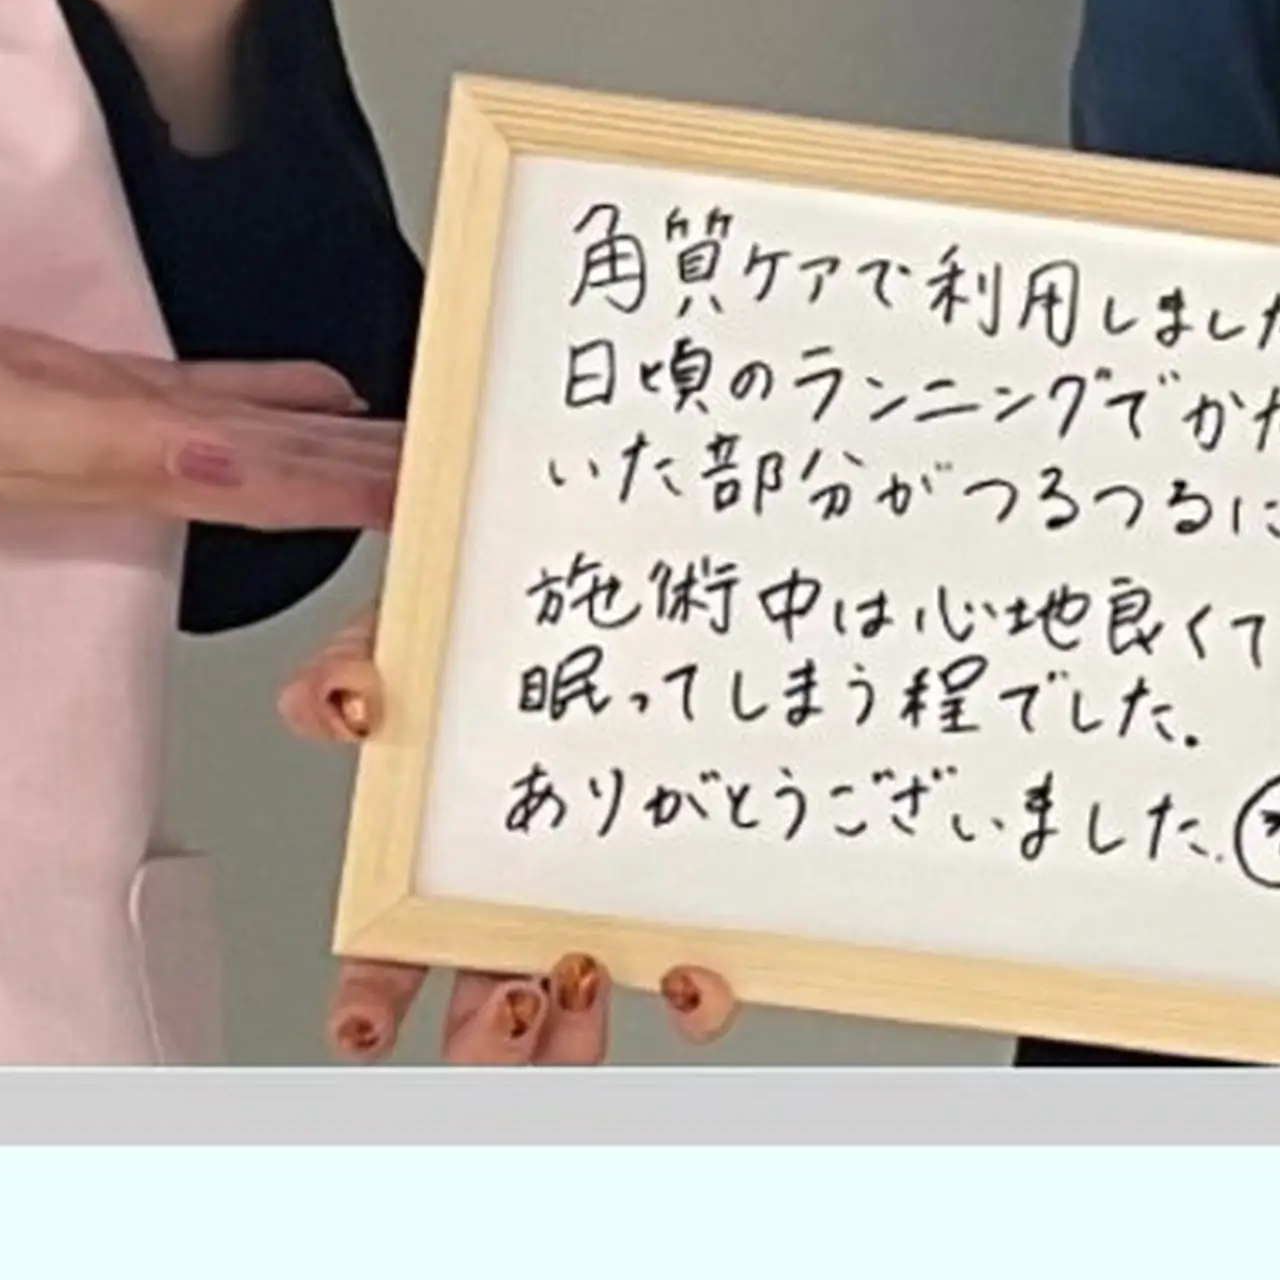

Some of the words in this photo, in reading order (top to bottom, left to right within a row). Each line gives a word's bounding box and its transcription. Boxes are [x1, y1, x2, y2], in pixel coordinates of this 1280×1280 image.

[525, 551, 1268, 670] 施術中は心地良くて
